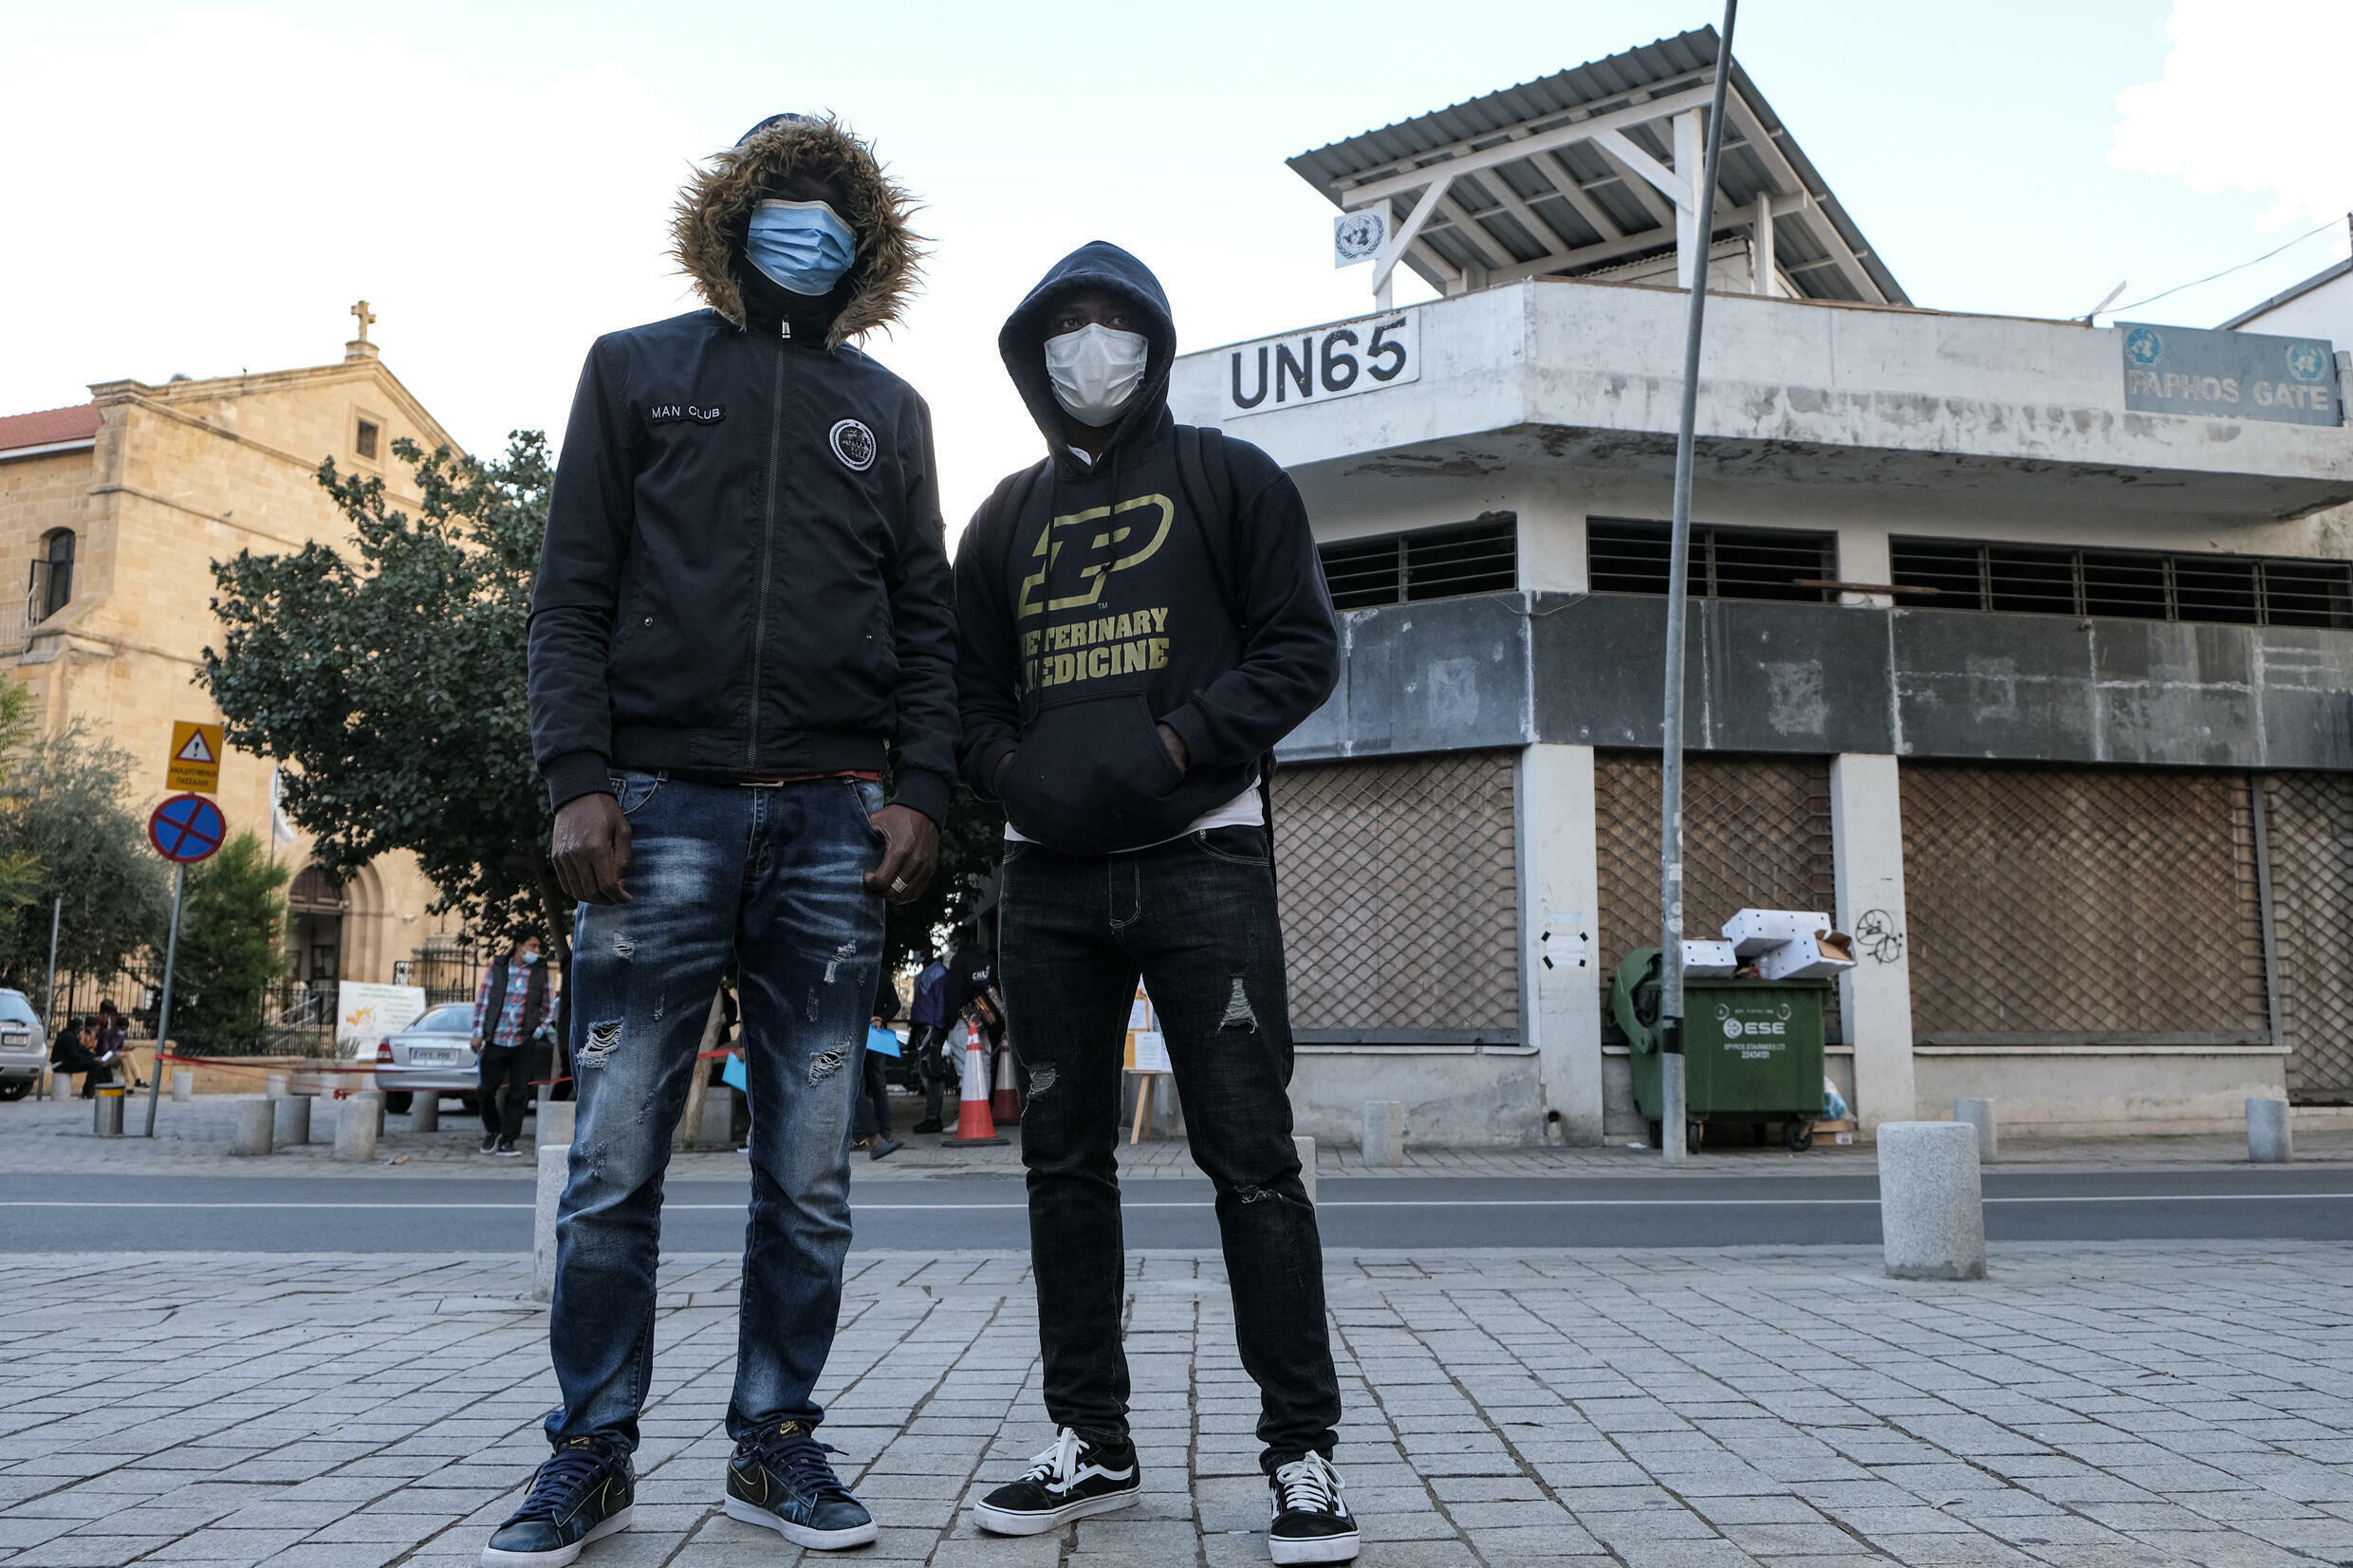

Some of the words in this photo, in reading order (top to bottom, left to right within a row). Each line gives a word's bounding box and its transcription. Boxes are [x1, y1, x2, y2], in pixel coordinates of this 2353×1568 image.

[1232, 317, 1406, 409] UN65
[2127, 369, 2239, 403] PAPHOS
[2253, 380, 2329, 411] GATE
[652, 405, 680, 418] MAN
[688, 405, 720, 419] CLUB
[1024, 607, 1169, 656] ETERINARY
[1744, 1022, 1786, 1035] ESE
